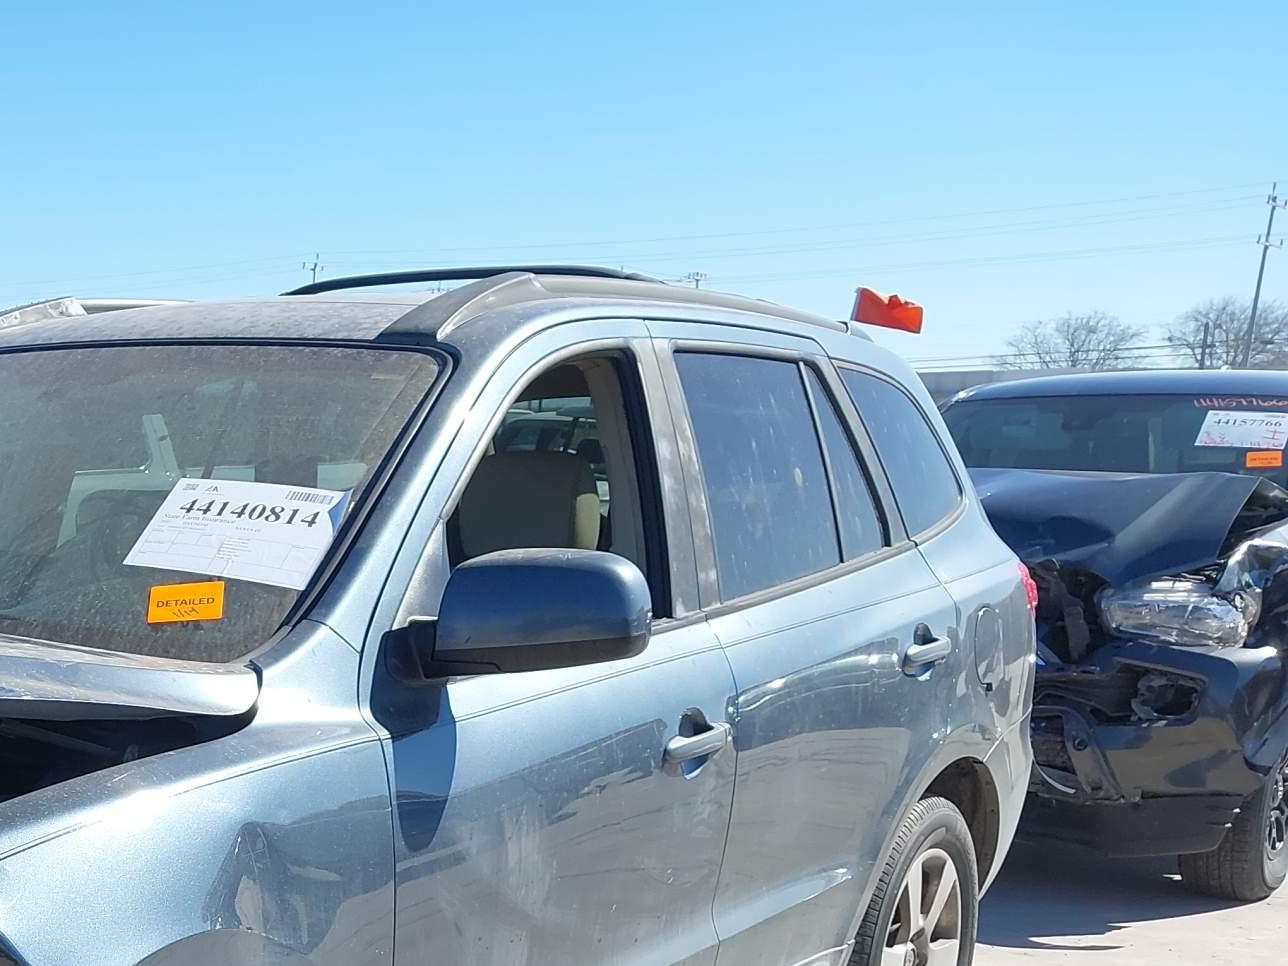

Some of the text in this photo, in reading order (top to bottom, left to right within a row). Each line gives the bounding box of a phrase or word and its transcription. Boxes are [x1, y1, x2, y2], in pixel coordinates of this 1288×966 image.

[1213, 418, 1282, 427] 44157766
[179, 497, 321, 528] 44140814
[156, 597, 215, 608] DETAILED
